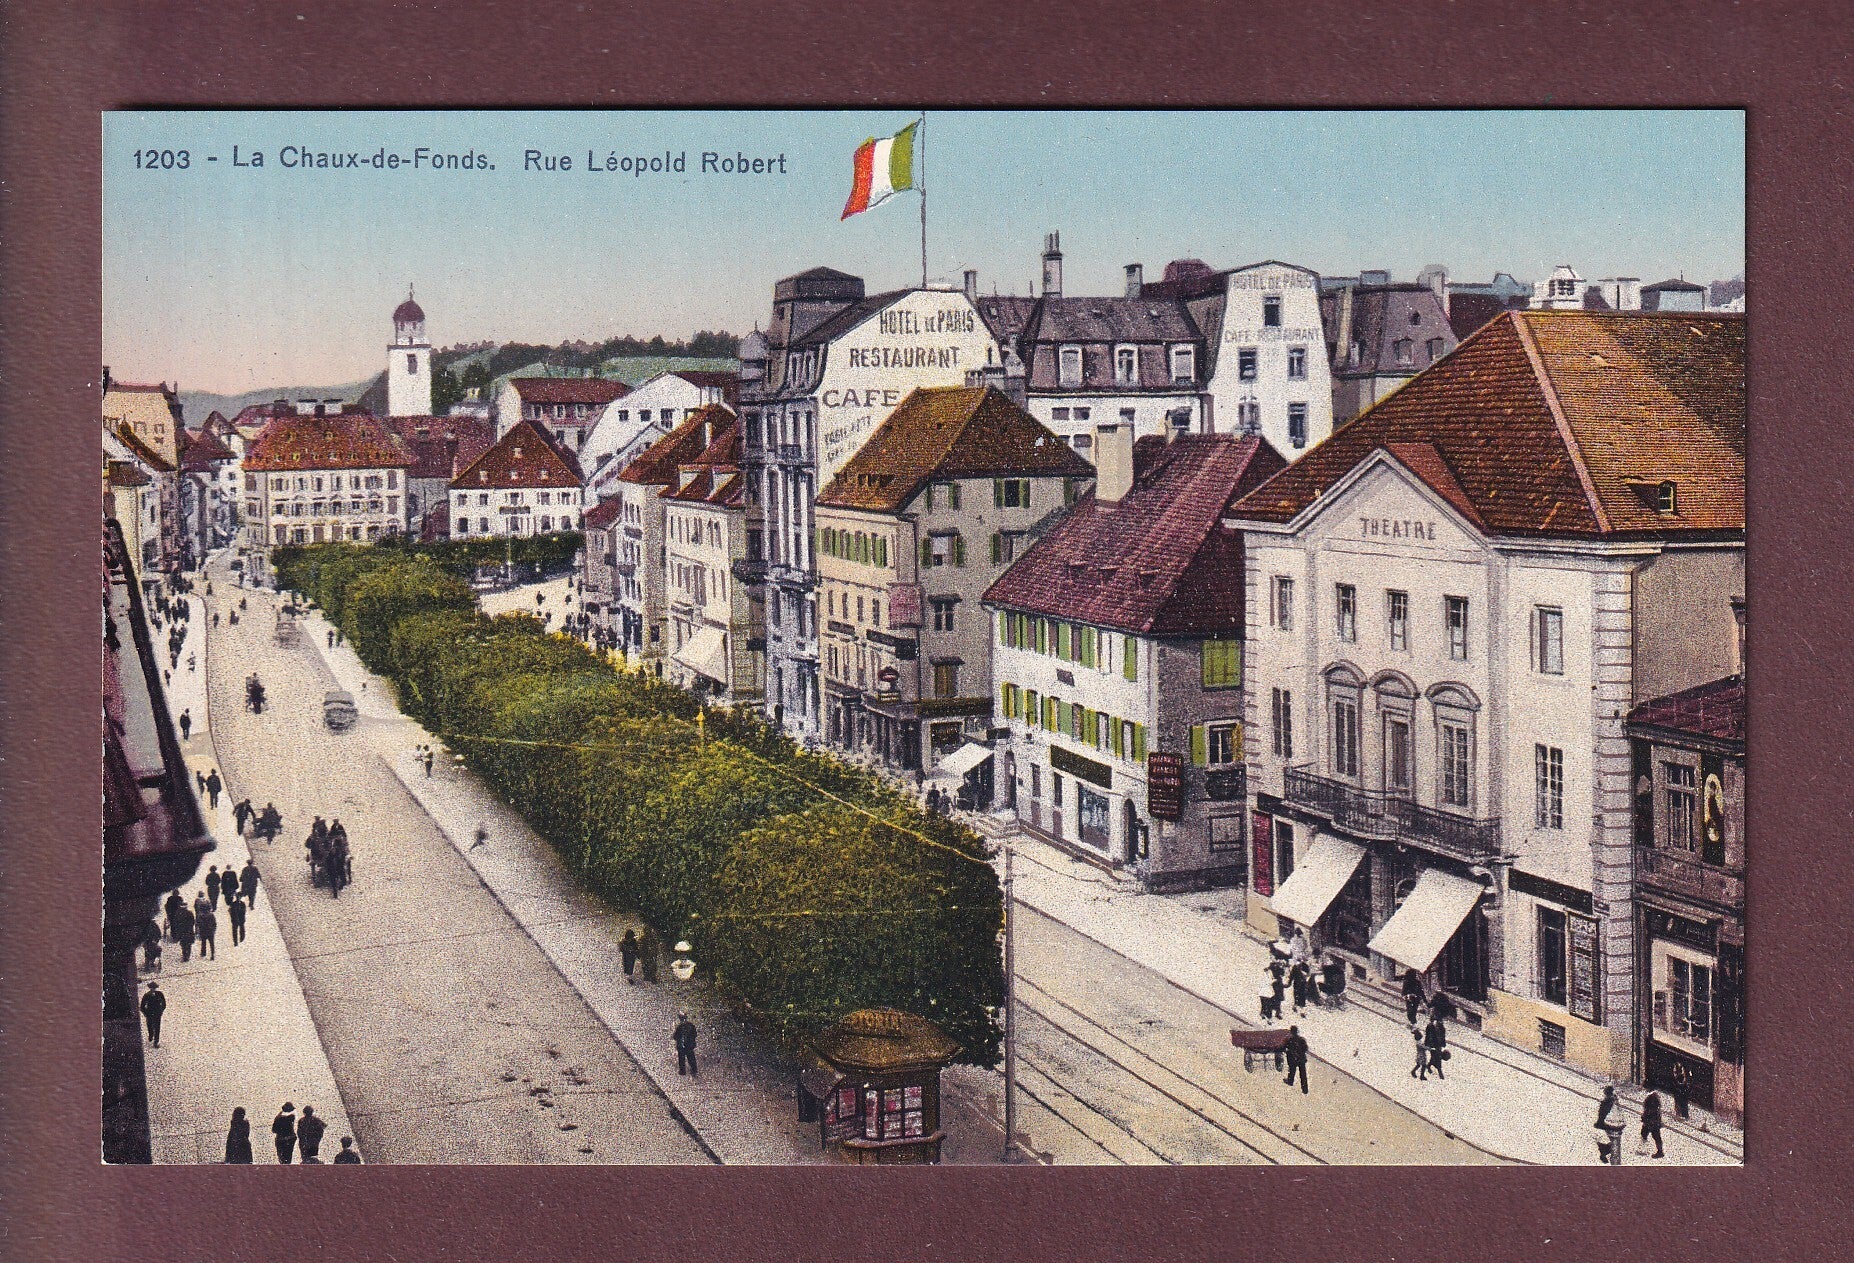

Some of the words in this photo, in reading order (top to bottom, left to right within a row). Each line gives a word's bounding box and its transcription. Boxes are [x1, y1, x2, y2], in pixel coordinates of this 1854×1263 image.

[880, 310, 920, 334] HOTEL
[938, 309, 974, 333] PARIS
[849, 346, 960, 368] RESTAURANT
[822, 389, 900, 408] CAFE
[1360, 517, 1436, 540] THEATRE
